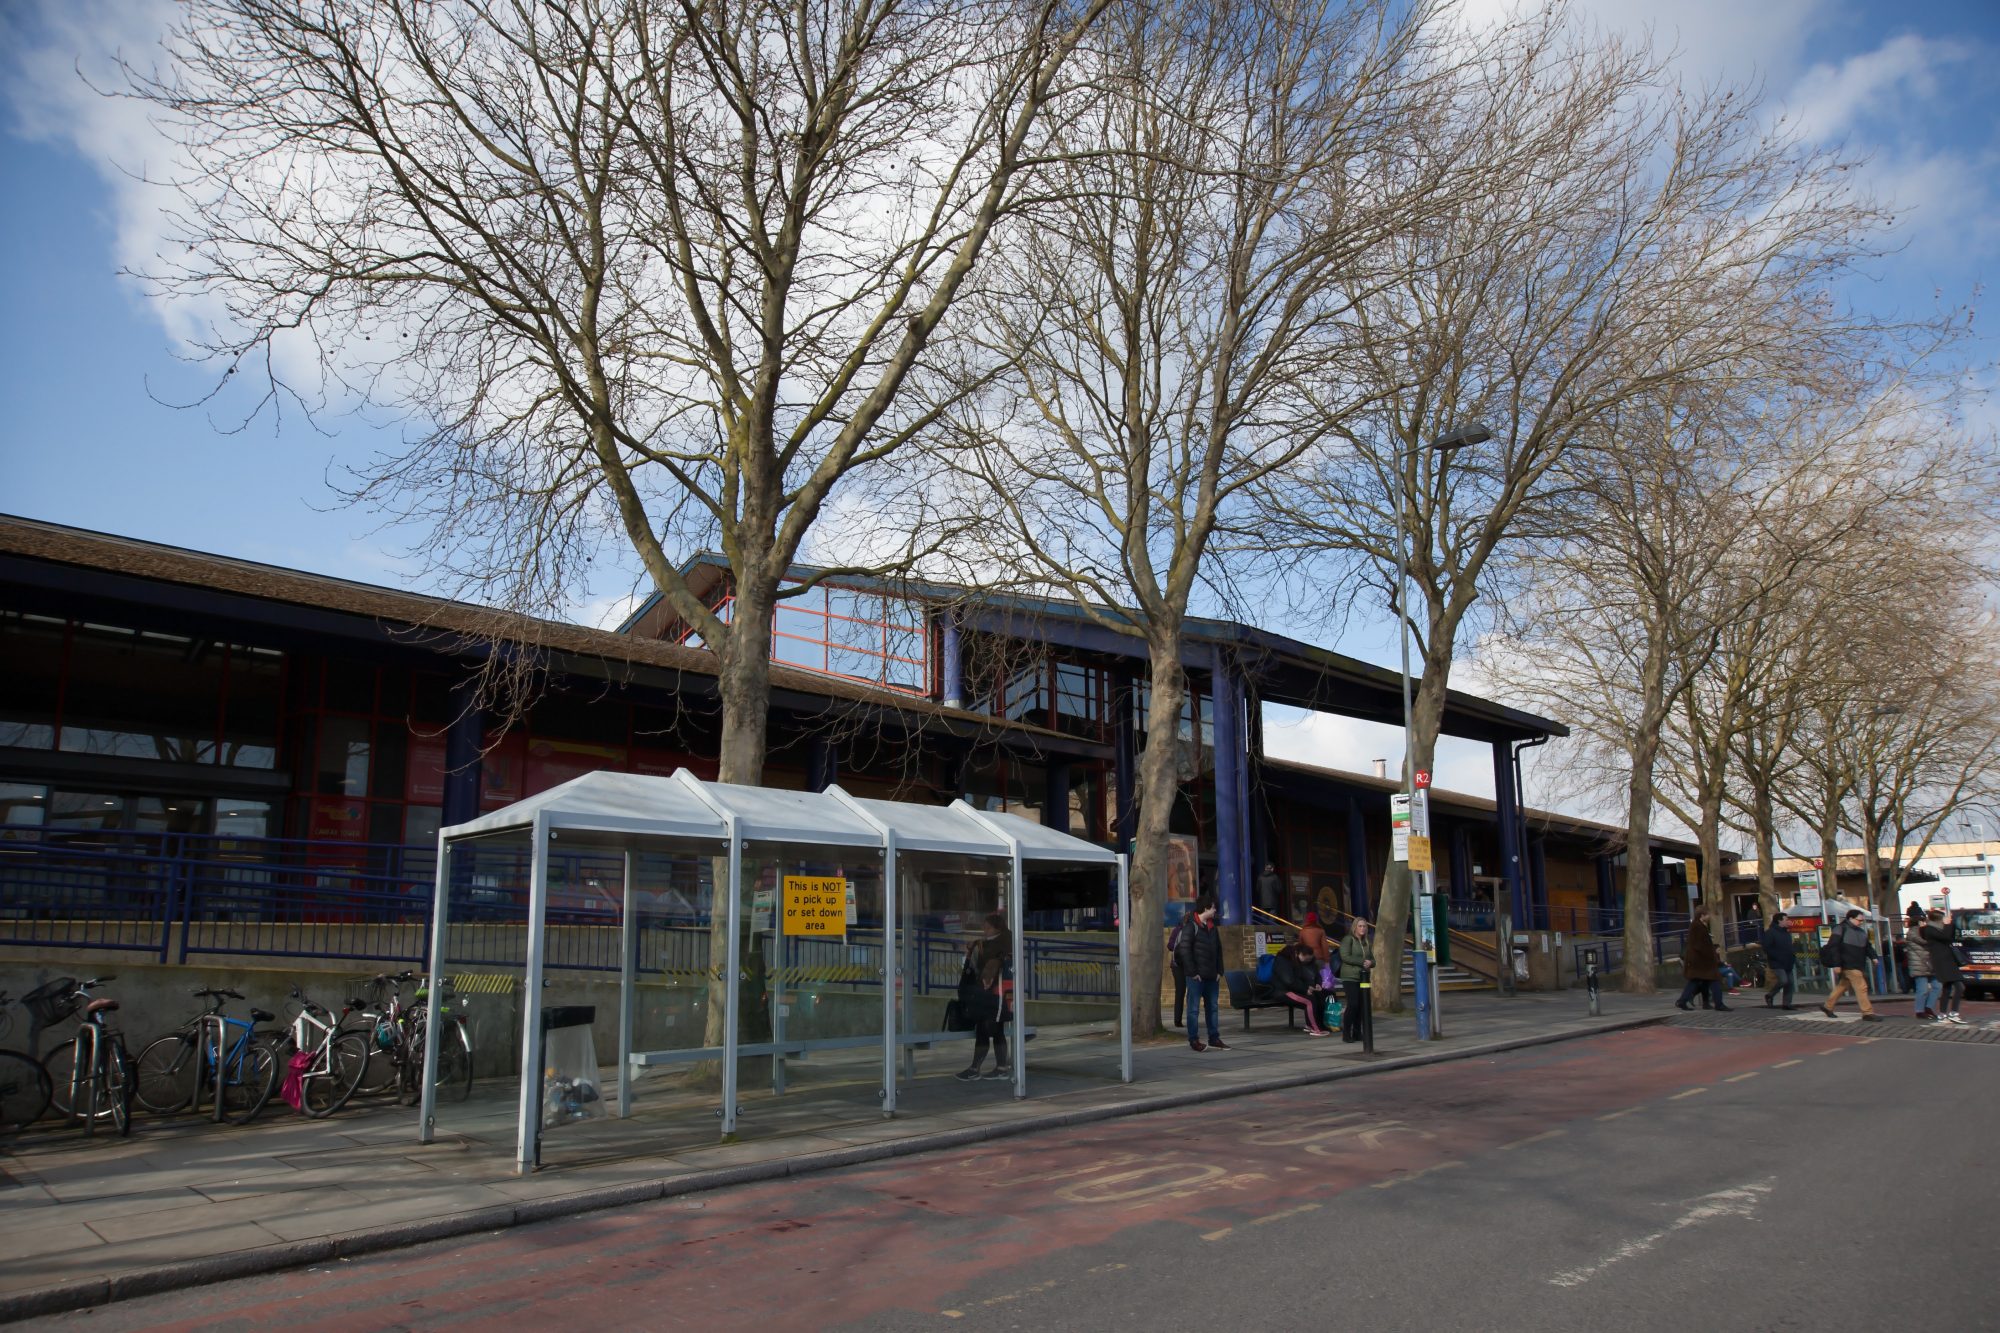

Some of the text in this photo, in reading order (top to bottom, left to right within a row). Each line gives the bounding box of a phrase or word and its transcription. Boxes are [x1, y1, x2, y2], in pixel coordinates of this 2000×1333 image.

[1416, 773, 1430, 783] R2
[789, 880, 841, 893] This is NOT
[793, 894, 837, 905] a pick up
[787, 908, 843, 917] or set down
[805, 922, 825, 930] area
